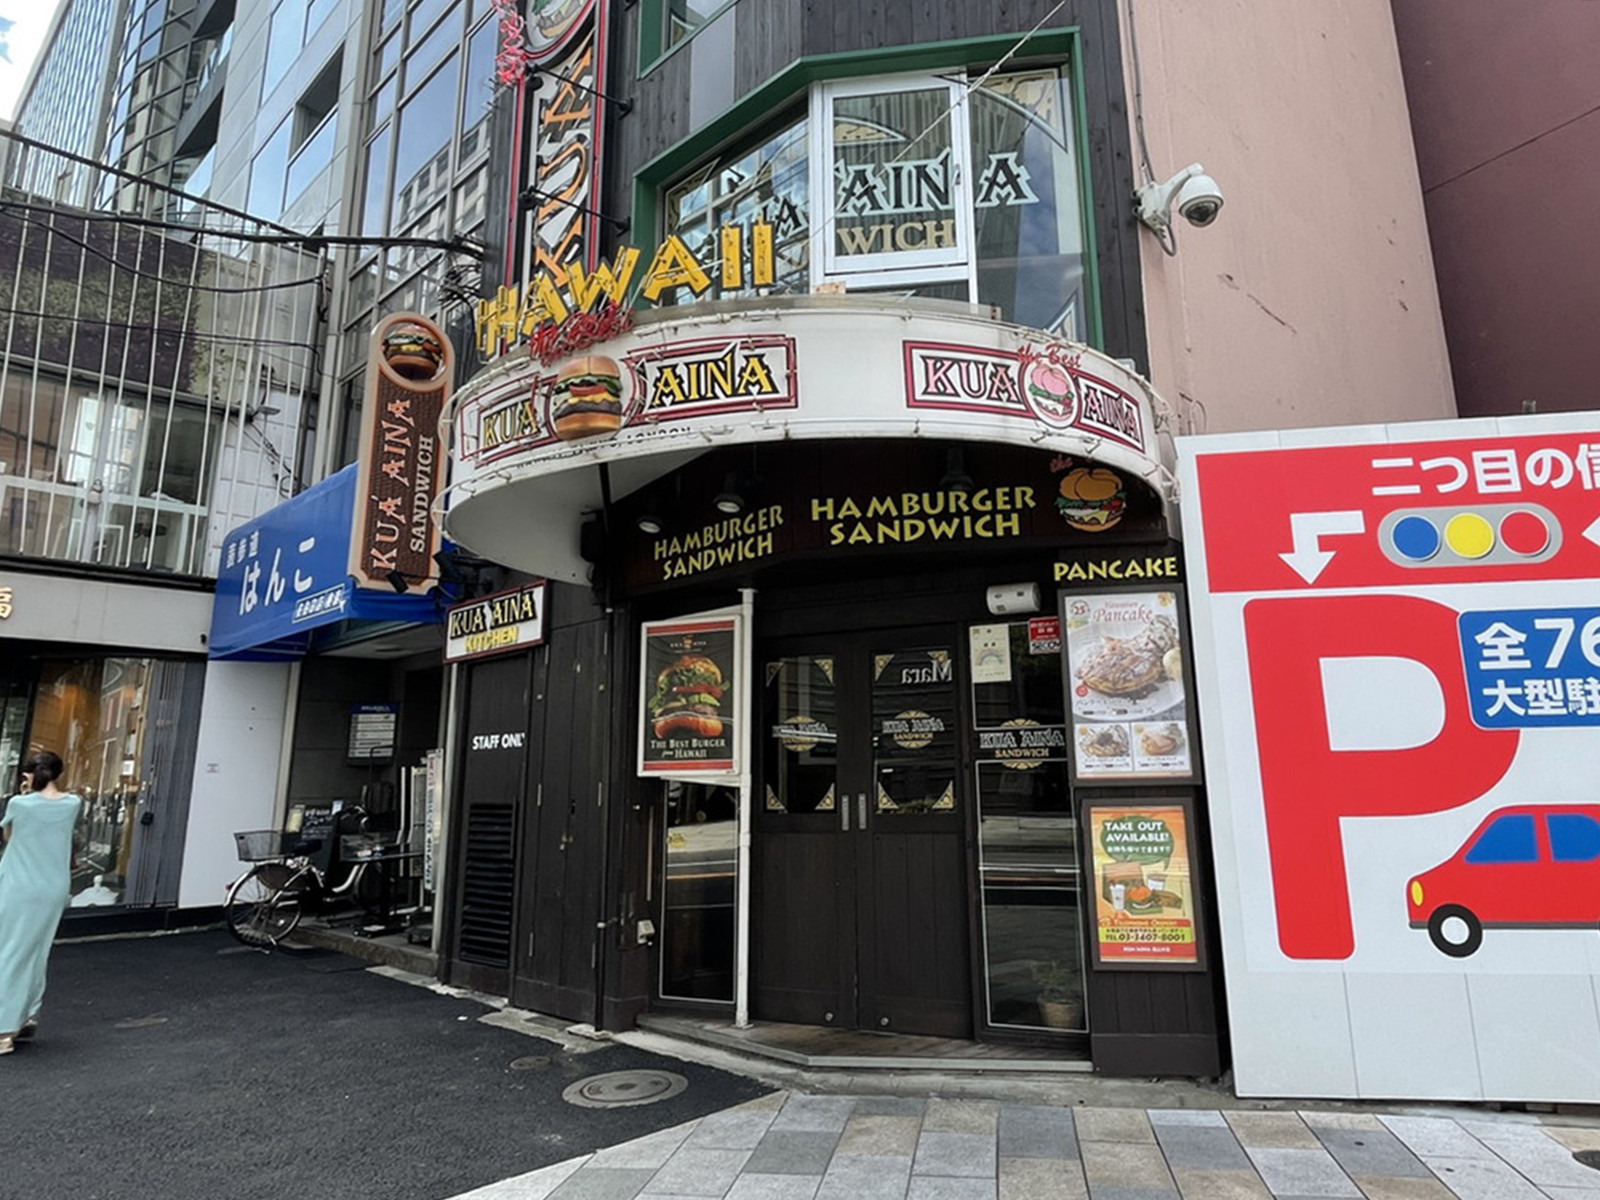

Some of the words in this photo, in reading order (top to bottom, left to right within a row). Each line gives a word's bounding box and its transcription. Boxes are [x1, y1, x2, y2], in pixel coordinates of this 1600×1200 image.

[476, 216, 777, 357] HAWAII
[920, 355, 1024, 405] KUA
[482, 400, 541, 449] KUA
[409, 434, 434, 554] SANDWICH
[811, 486, 1037, 521] HAMBURGER
[654, 505, 784, 561] HAMBURGER
[830, 513, 1020, 546] SANDWICH
[663, 532, 773, 581] SANDWICH
[1053, 557, 1178, 582] PANCAKE
[239, 536, 316, 616] はんこ
[450, 605, 488, 641] KUA
[1093, 603, 1153, 625] Pancake
[464, 625, 519, 654] KITCHEN
[472, 735, 500, 750] STAFF
[501, 732, 525, 749] ONL
[980, 732, 1017, 748] KUA
[995, 748, 1050, 759] SANDWICH
[1242, 594, 1521, 960] P
[1104, 822, 1134, 831] TAKE
[1137, 821, 1163, 831] OUT
